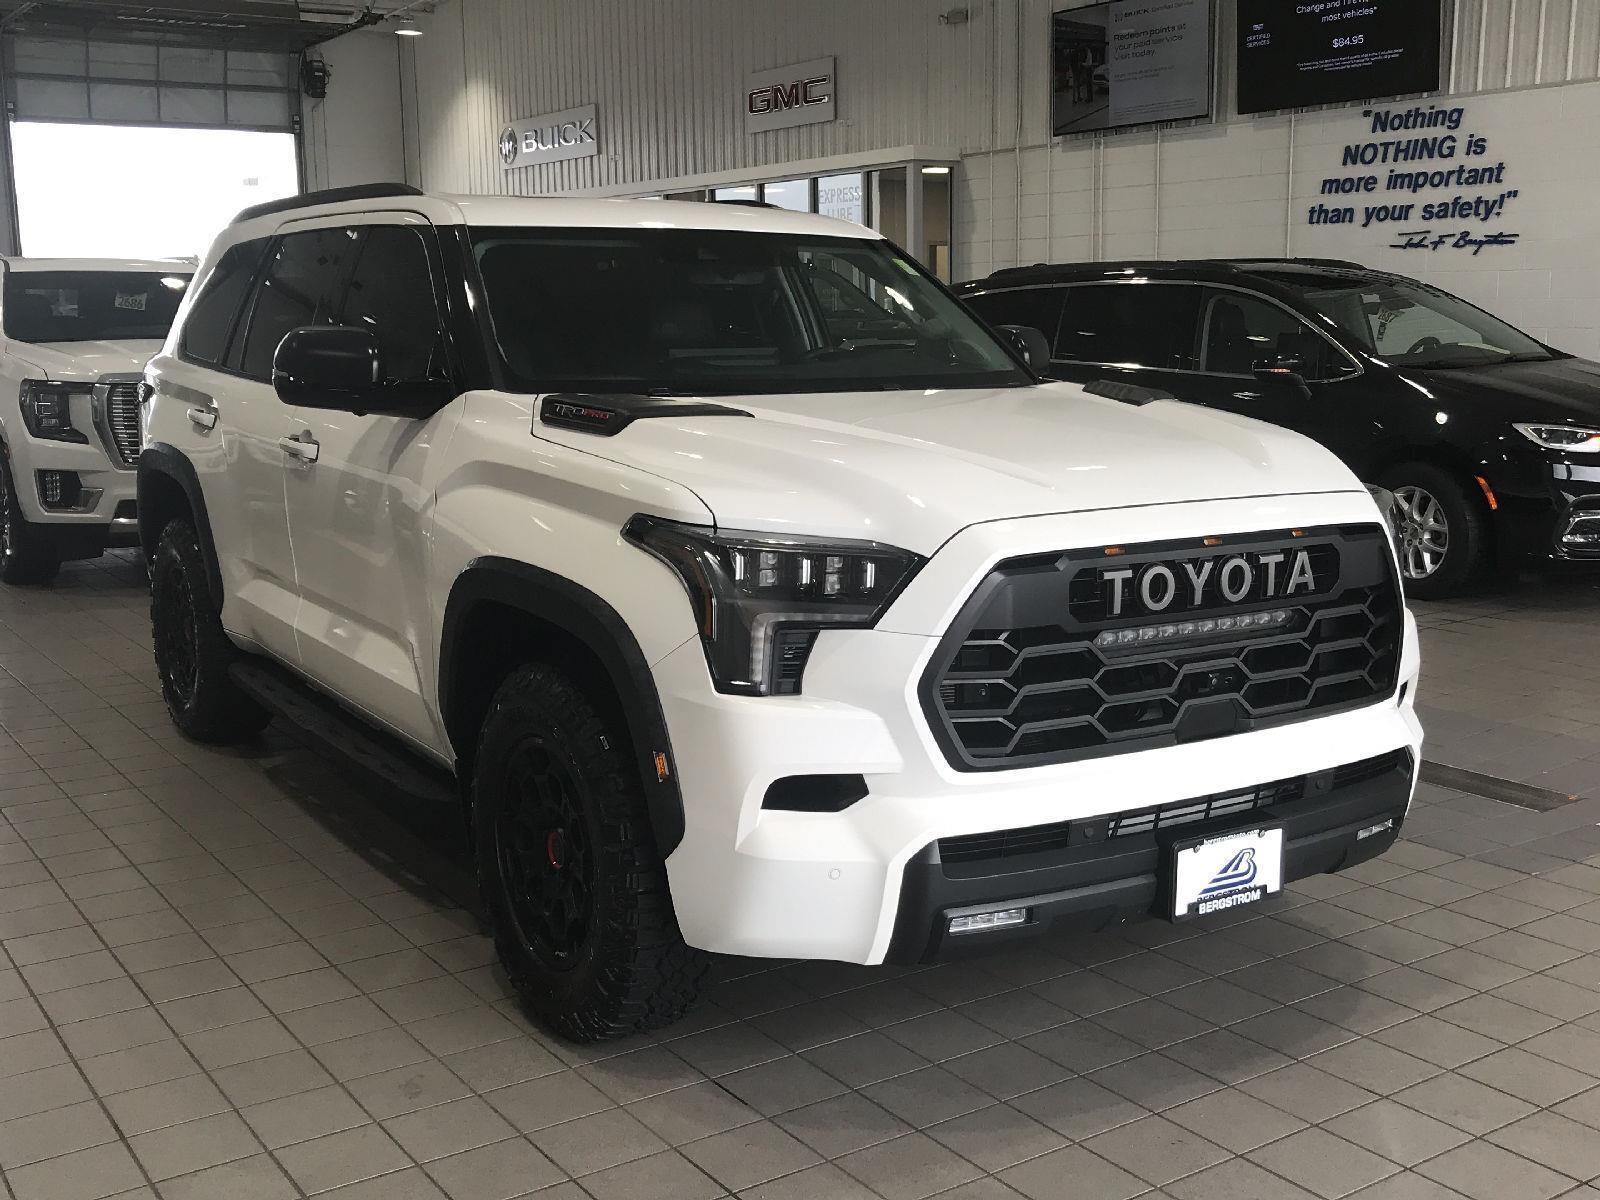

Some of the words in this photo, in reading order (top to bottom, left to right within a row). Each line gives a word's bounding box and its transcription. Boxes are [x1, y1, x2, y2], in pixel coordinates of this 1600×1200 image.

[1296, 3, 1325, 14] Change
[1326, 0, 1341, 9] and
[1321, 13, 1341, 23] most
[1113, 29, 1149, 41] Redeem
[1149, 26, 1176, 38] points
[1332, 34, 1364, 49] $84.95
[1131, 49, 1156, 59] today
[749, 75, 830, 115] GMC
[522, 117, 596, 153] BUICK
[1341, 135, 1457, 167] NOTHING
[1465, 133, 1488, 156] is
[1320, 176, 1378, 195] more
[1386, 162, 1506, 193] important
[818, 186, 861, 204] EXPRESS
[1308, 203, 1354, 225] than
[1361, 203, 1415, 228] your
[1103, 551, 1315, 615] TOYOTA
[1198, 889, 1261, 915] BERGSTROM
